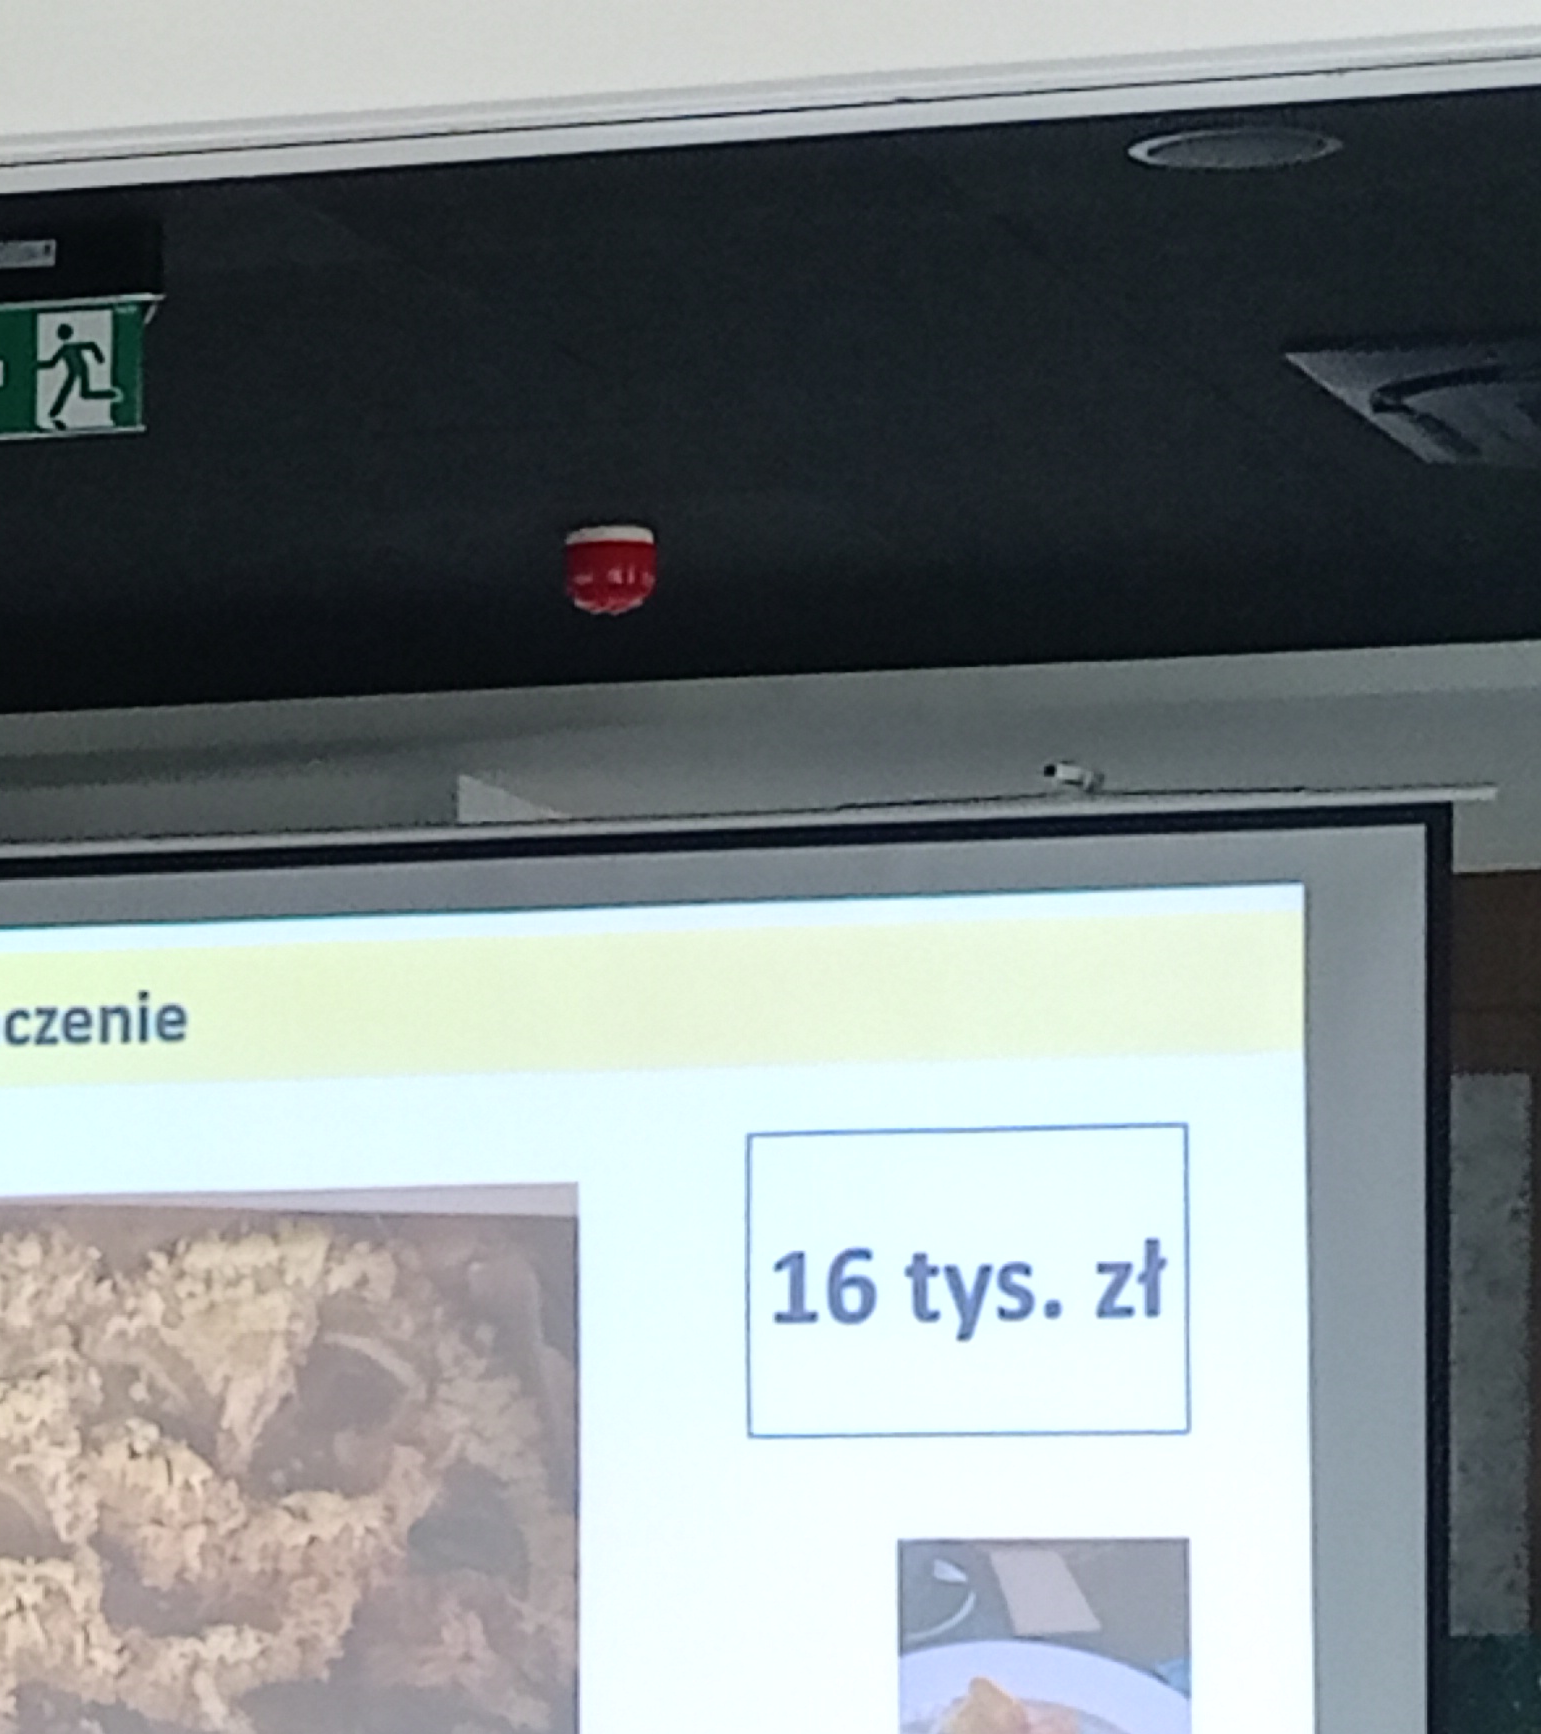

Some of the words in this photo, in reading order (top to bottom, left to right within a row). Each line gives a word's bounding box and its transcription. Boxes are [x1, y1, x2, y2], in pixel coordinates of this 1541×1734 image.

[773, 1247, 877, 1325] 16
[904, 1251, 1063, 1341] tys.
[1094, 1237, 1167, 1319] zł
